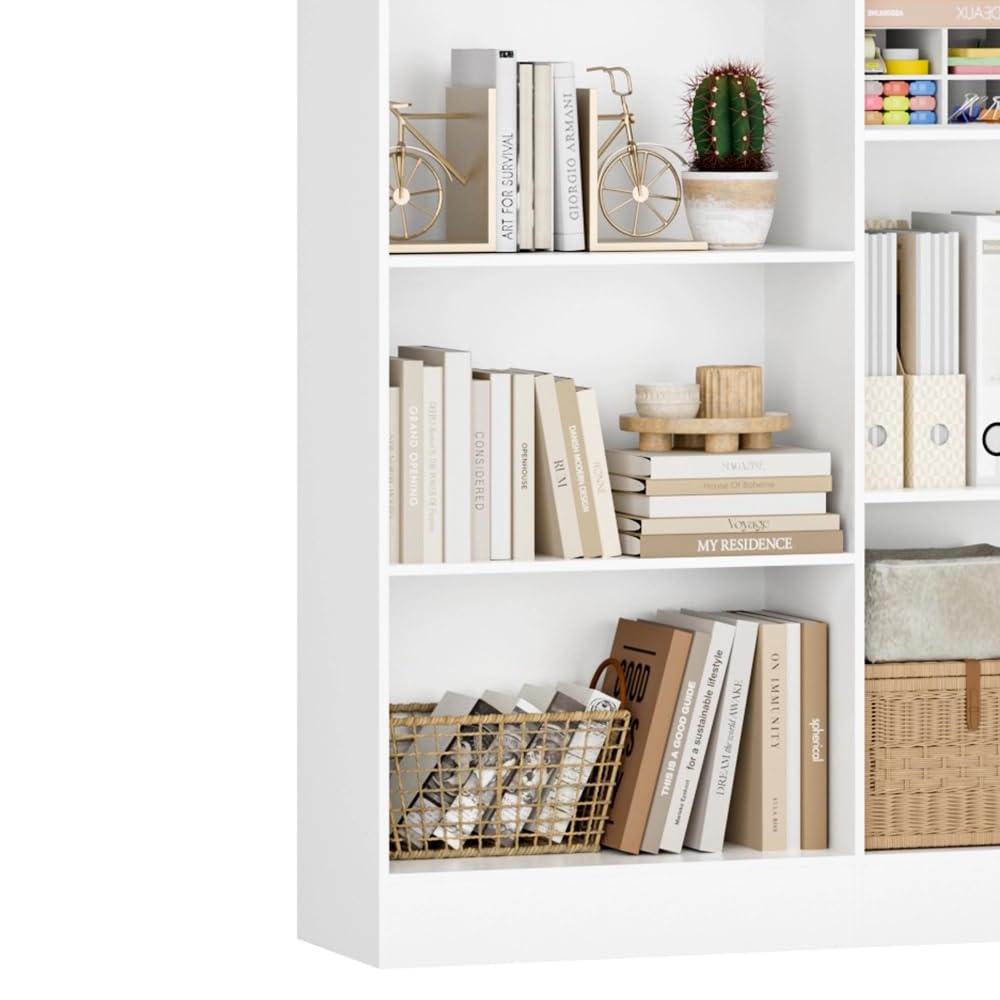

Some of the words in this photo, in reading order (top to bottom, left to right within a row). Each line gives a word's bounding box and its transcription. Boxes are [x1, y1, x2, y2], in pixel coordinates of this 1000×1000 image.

[563, 93, 576, 152] ARMANI
[502, 134, 513, 186] SURVIVAL
[501, 191, 513, 213] FOR
[567, 158, 579, 220] GIORGIO
[502, 219, 512, 240] ART
[409, 407, 418, 447] GRAND
[409, 453, 418, 506] OPENING
[474, 432, 484, 511] CONSIDERED
[697, 539, 718, 552] MY
[721, 538, 792, 551] RESIDENCE
[728, 519, 769, 532] Voyage
[772, 653, 779, 670] ON
[681, 680, 696, 715] GUIDE
[686, 756, 696, 770] for
[695, 689, 713, 745] sustainable
[707, 650, 723, 687] lifestyle
[771, 679, 780, 747] IMMUNITY
[673, 716, 687, 748] GOOD
[716, 755, 730, 795] DREAM
[725, 743, 733, 754] the
[730, 680, 743, 716] AWAKE
[810, 717, 823, 763] spherical
[671, 750, 679, 759] A
[661, 772, 673, 797] THIS
